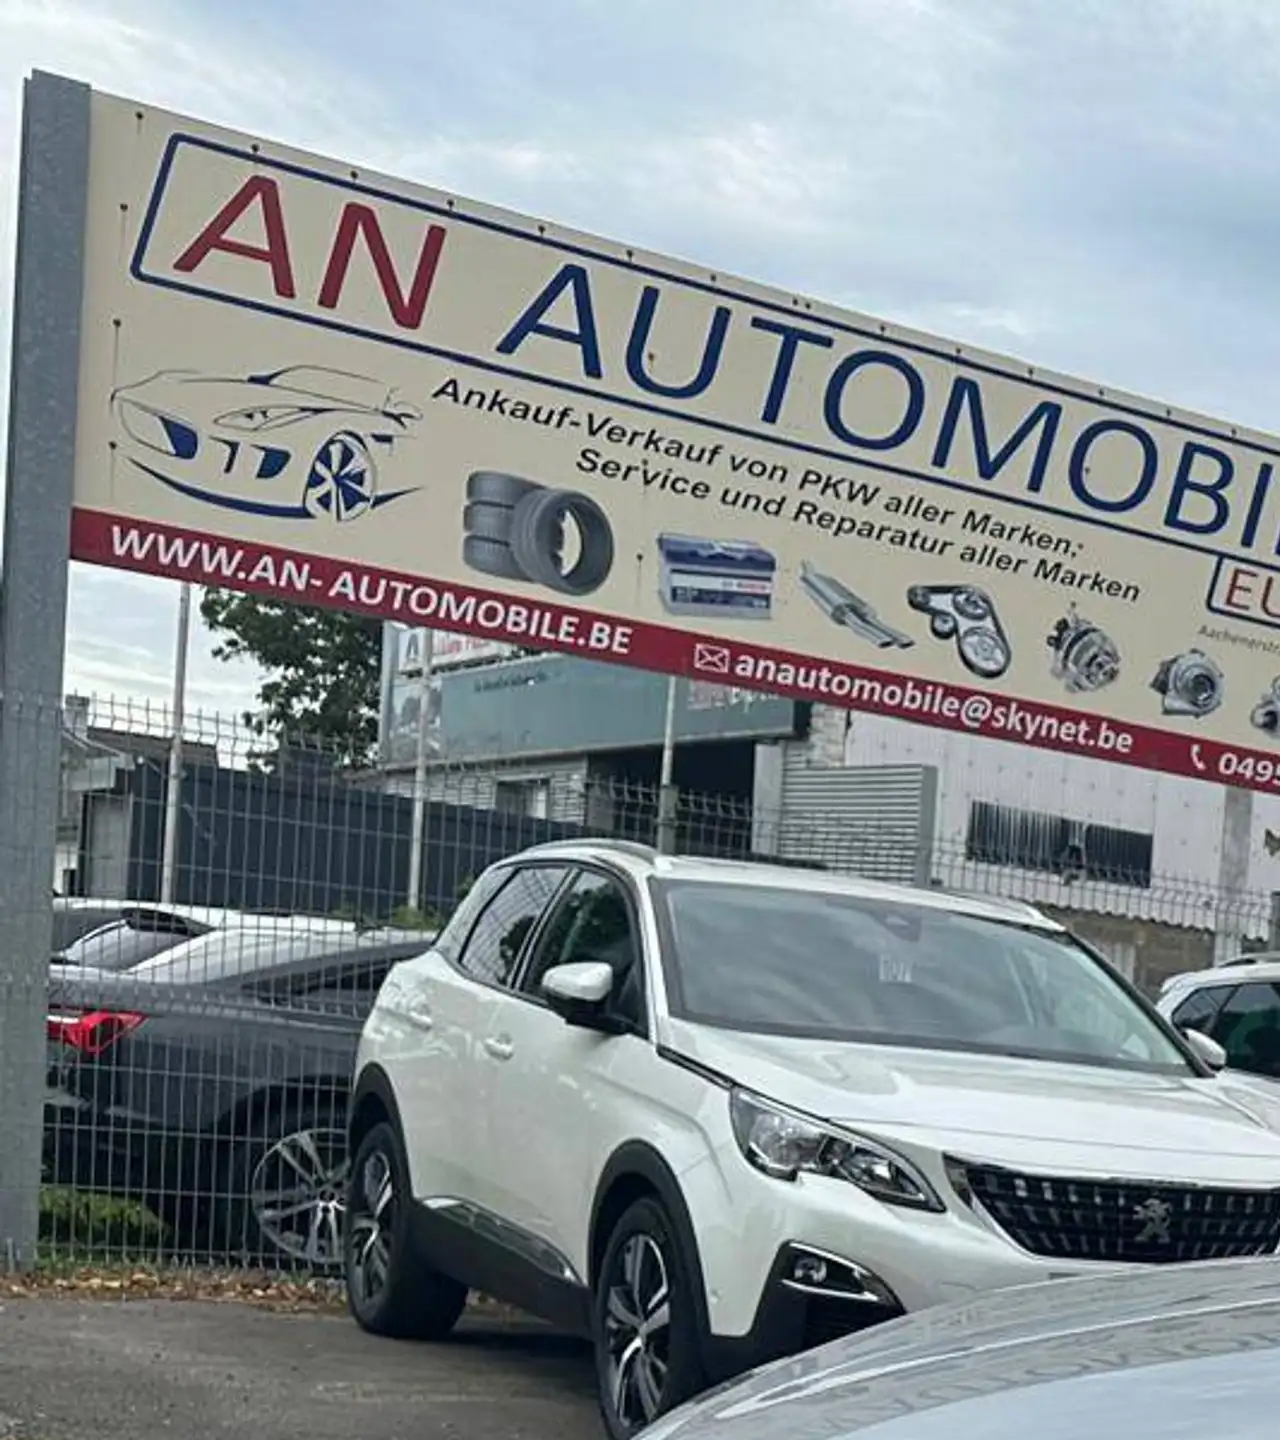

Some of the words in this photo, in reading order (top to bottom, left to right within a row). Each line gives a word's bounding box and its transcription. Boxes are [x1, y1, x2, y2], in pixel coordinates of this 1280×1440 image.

[172, 175, 447, 330] AN
[431, 377, 724, 467] Ankauf-Verkauf
[729, 453, 788, 483] von
[798, 469, 882, 508] PKW
[883, 494, 957, 526] aller
[575, 448, 712, 501] Service
[719, 486, 787, 518] und
[793, 500, 955, 557] Reparatur
[959, 543, 1029, 575] aller
[1033, 557, 1142, 604] Marken
[734, 651, 1133, 754] anautomobile@skynet.be
